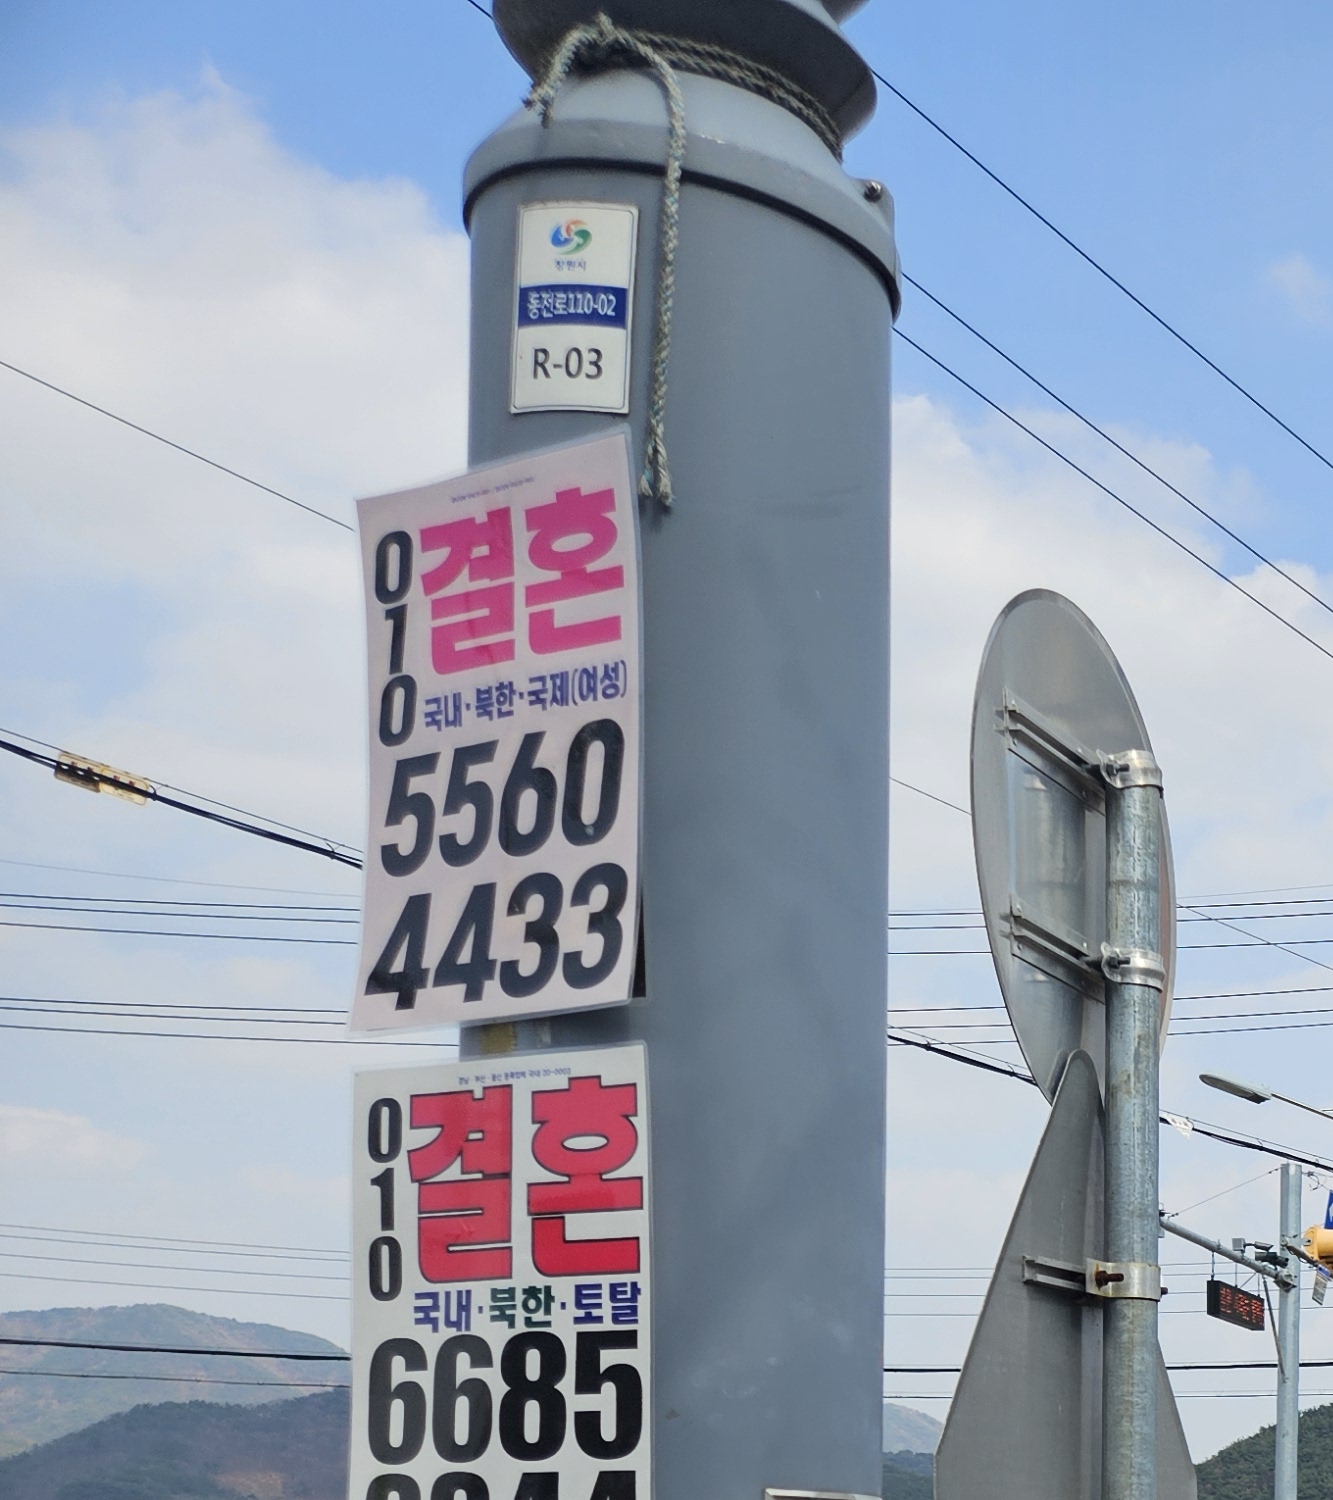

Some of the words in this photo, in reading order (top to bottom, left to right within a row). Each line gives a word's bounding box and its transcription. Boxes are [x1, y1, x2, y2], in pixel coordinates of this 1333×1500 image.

[528, 290, 617, 320] 동전로110-02
[554, 259, 587, 272] 창원시
[532, 346, 604, 380] R-03
[418, 486, 626, 677] 결혼
[380, 717, 625, 878] 5560
[364, 863, 629, 1012] 4433
[407, 1075, 645, 1284] 결혼
[367, 1330, 644, 1466] 6685
